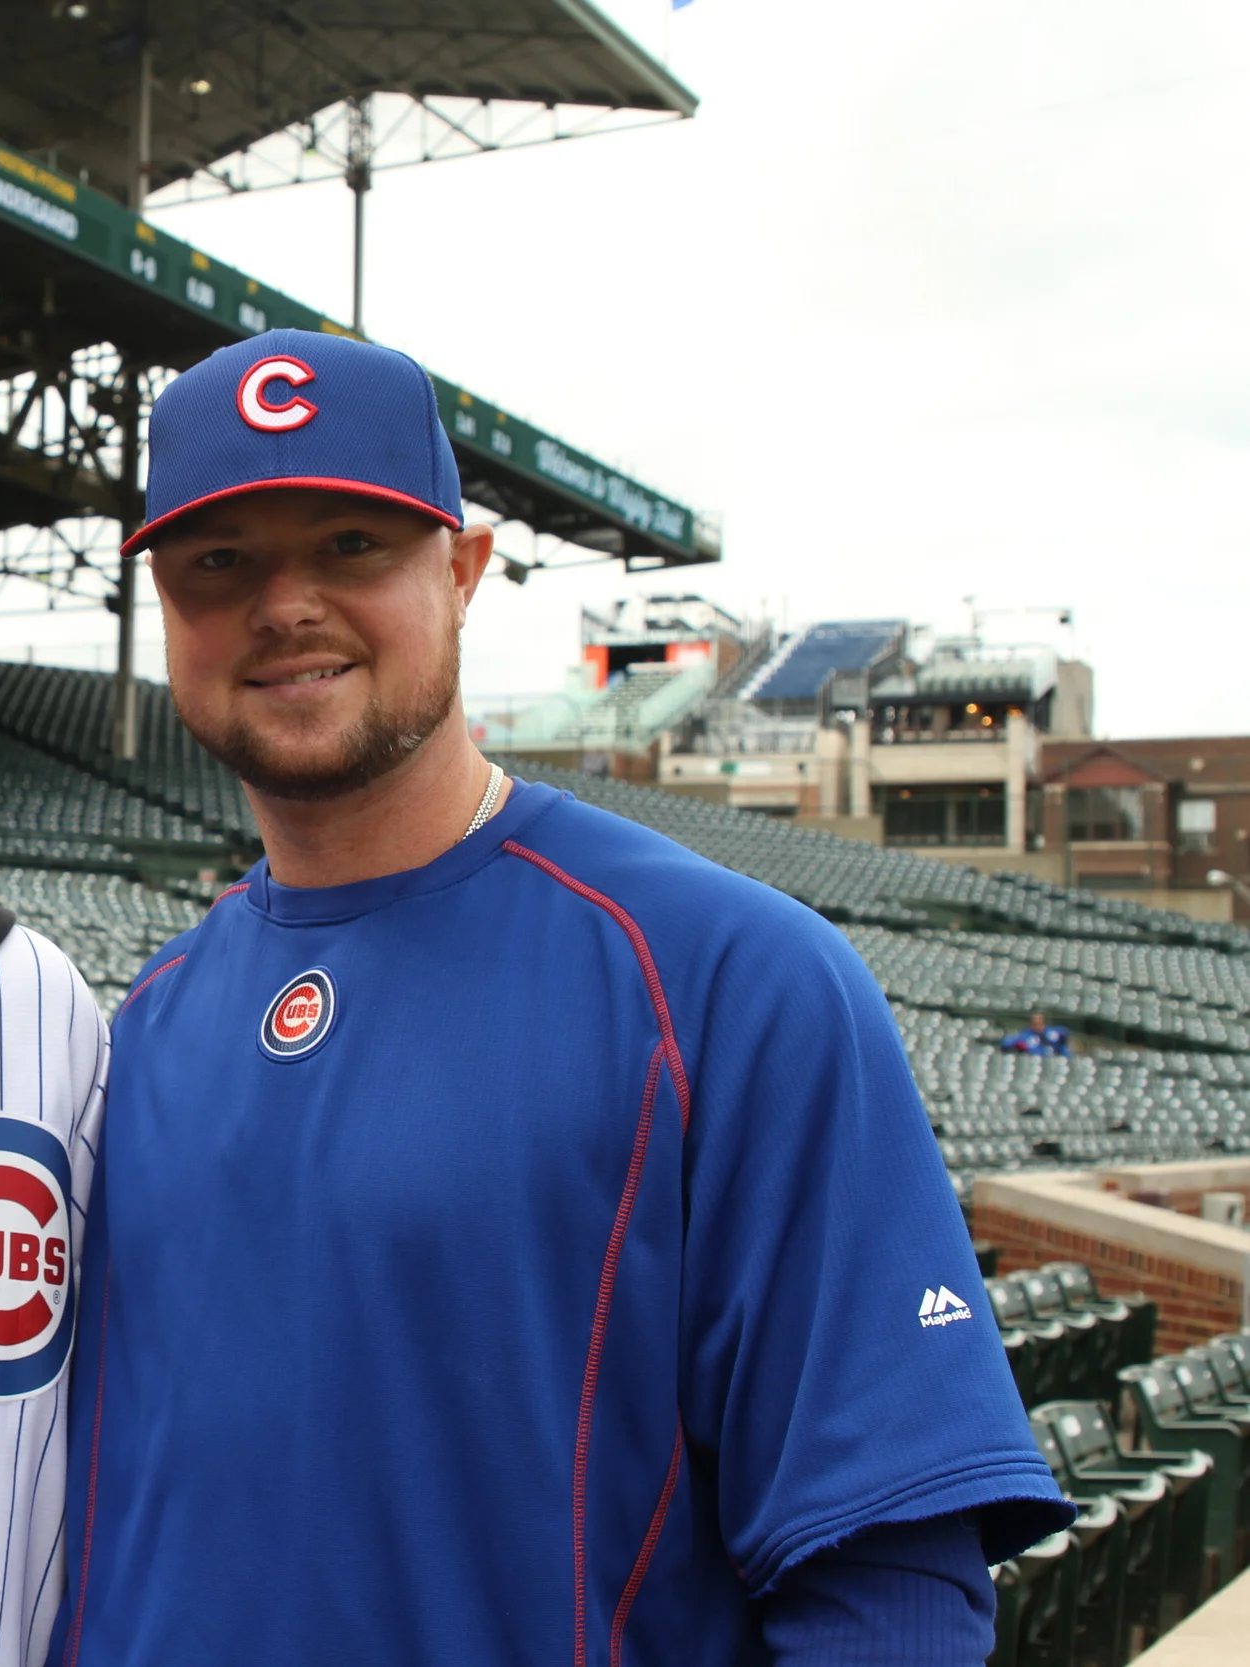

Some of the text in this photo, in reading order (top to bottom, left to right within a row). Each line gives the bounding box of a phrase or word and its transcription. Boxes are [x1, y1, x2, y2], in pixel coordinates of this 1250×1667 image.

[236, 354, 319, 432] C
[275, 986, 319, 1038] CUBS
[919, 1308, 972, 1328] Majestic
